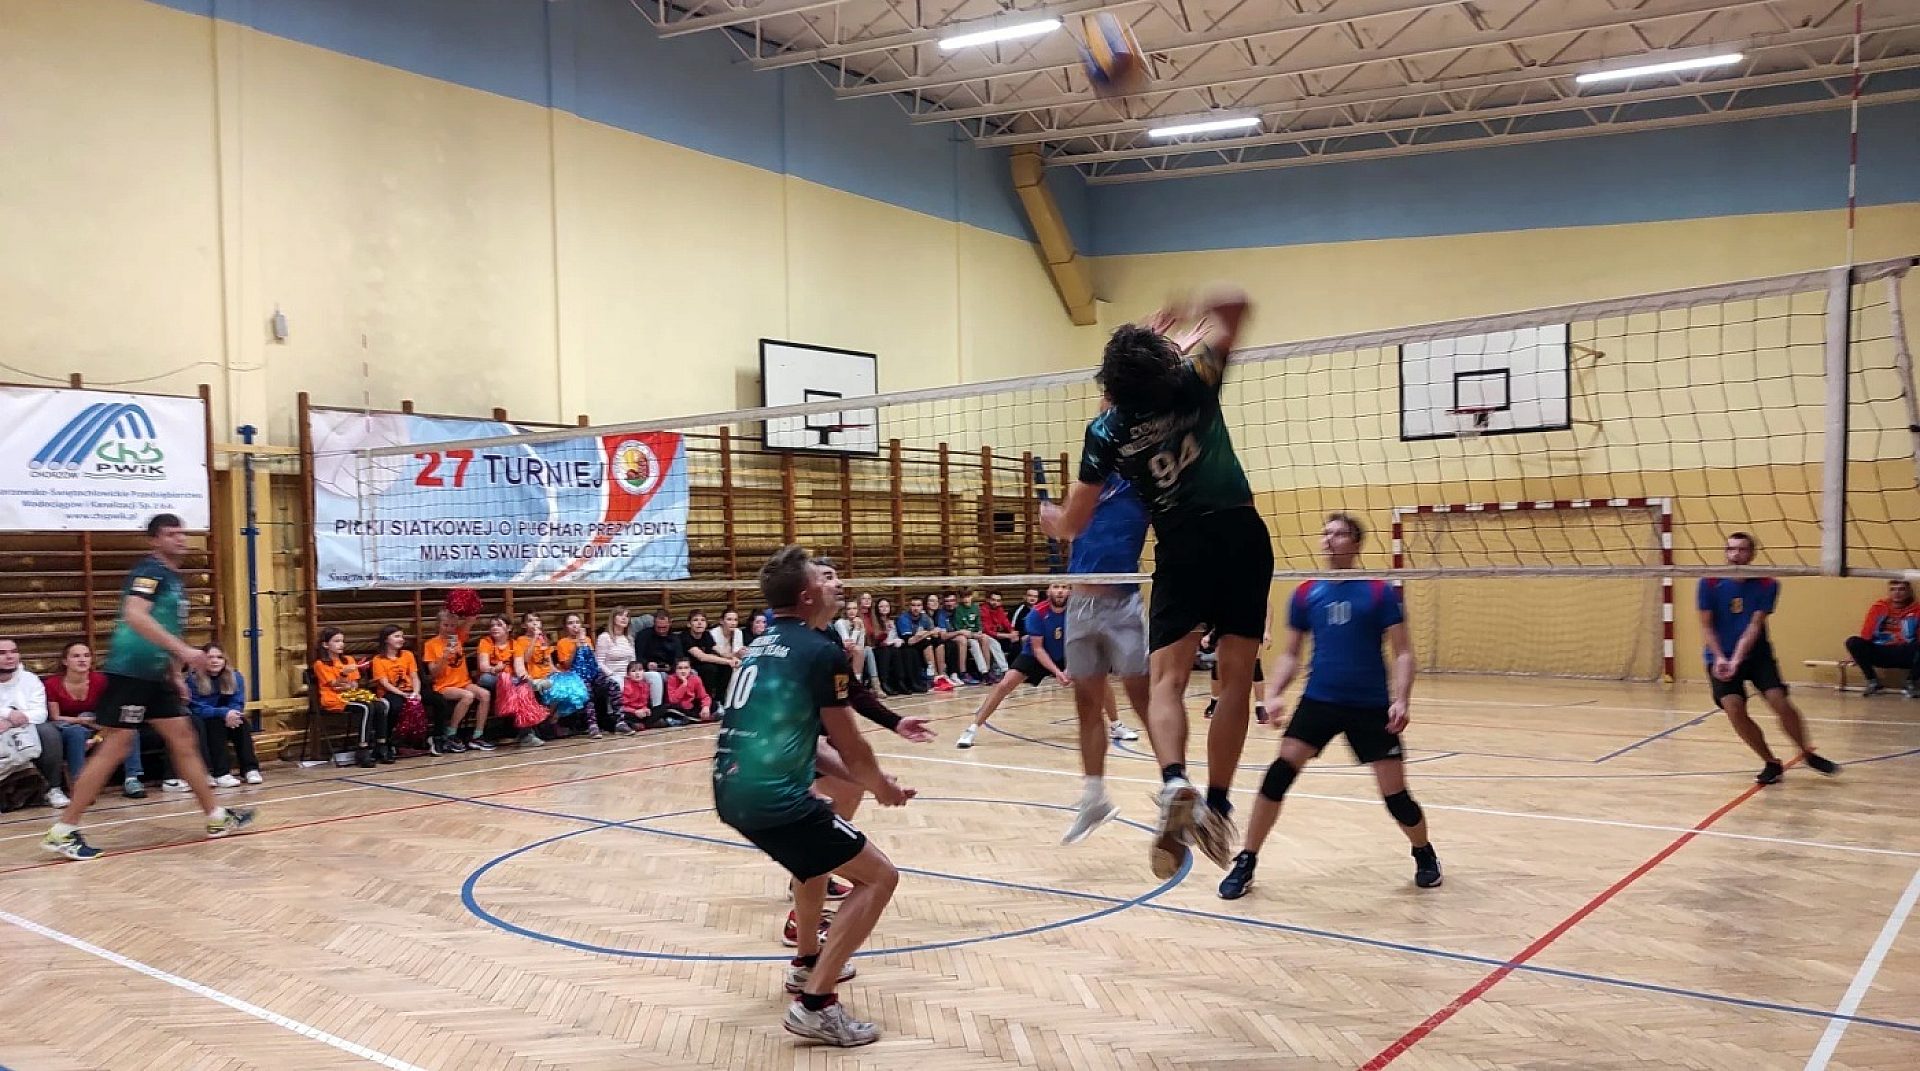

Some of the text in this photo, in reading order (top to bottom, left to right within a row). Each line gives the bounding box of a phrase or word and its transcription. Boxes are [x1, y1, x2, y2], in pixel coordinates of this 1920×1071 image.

[95, 463, 164, 474] PWiK
[414, 449, 604, 489] 27 TURNIEJ
[335, 519, 678, 537] PIŁKI SIATKOWEJ O PUCHAR PREZYDENTA
[420, 544, 482, 561] MIASTA
[1328, 601, 1352, 625] 10
[724, 664, 758, 710] 10
